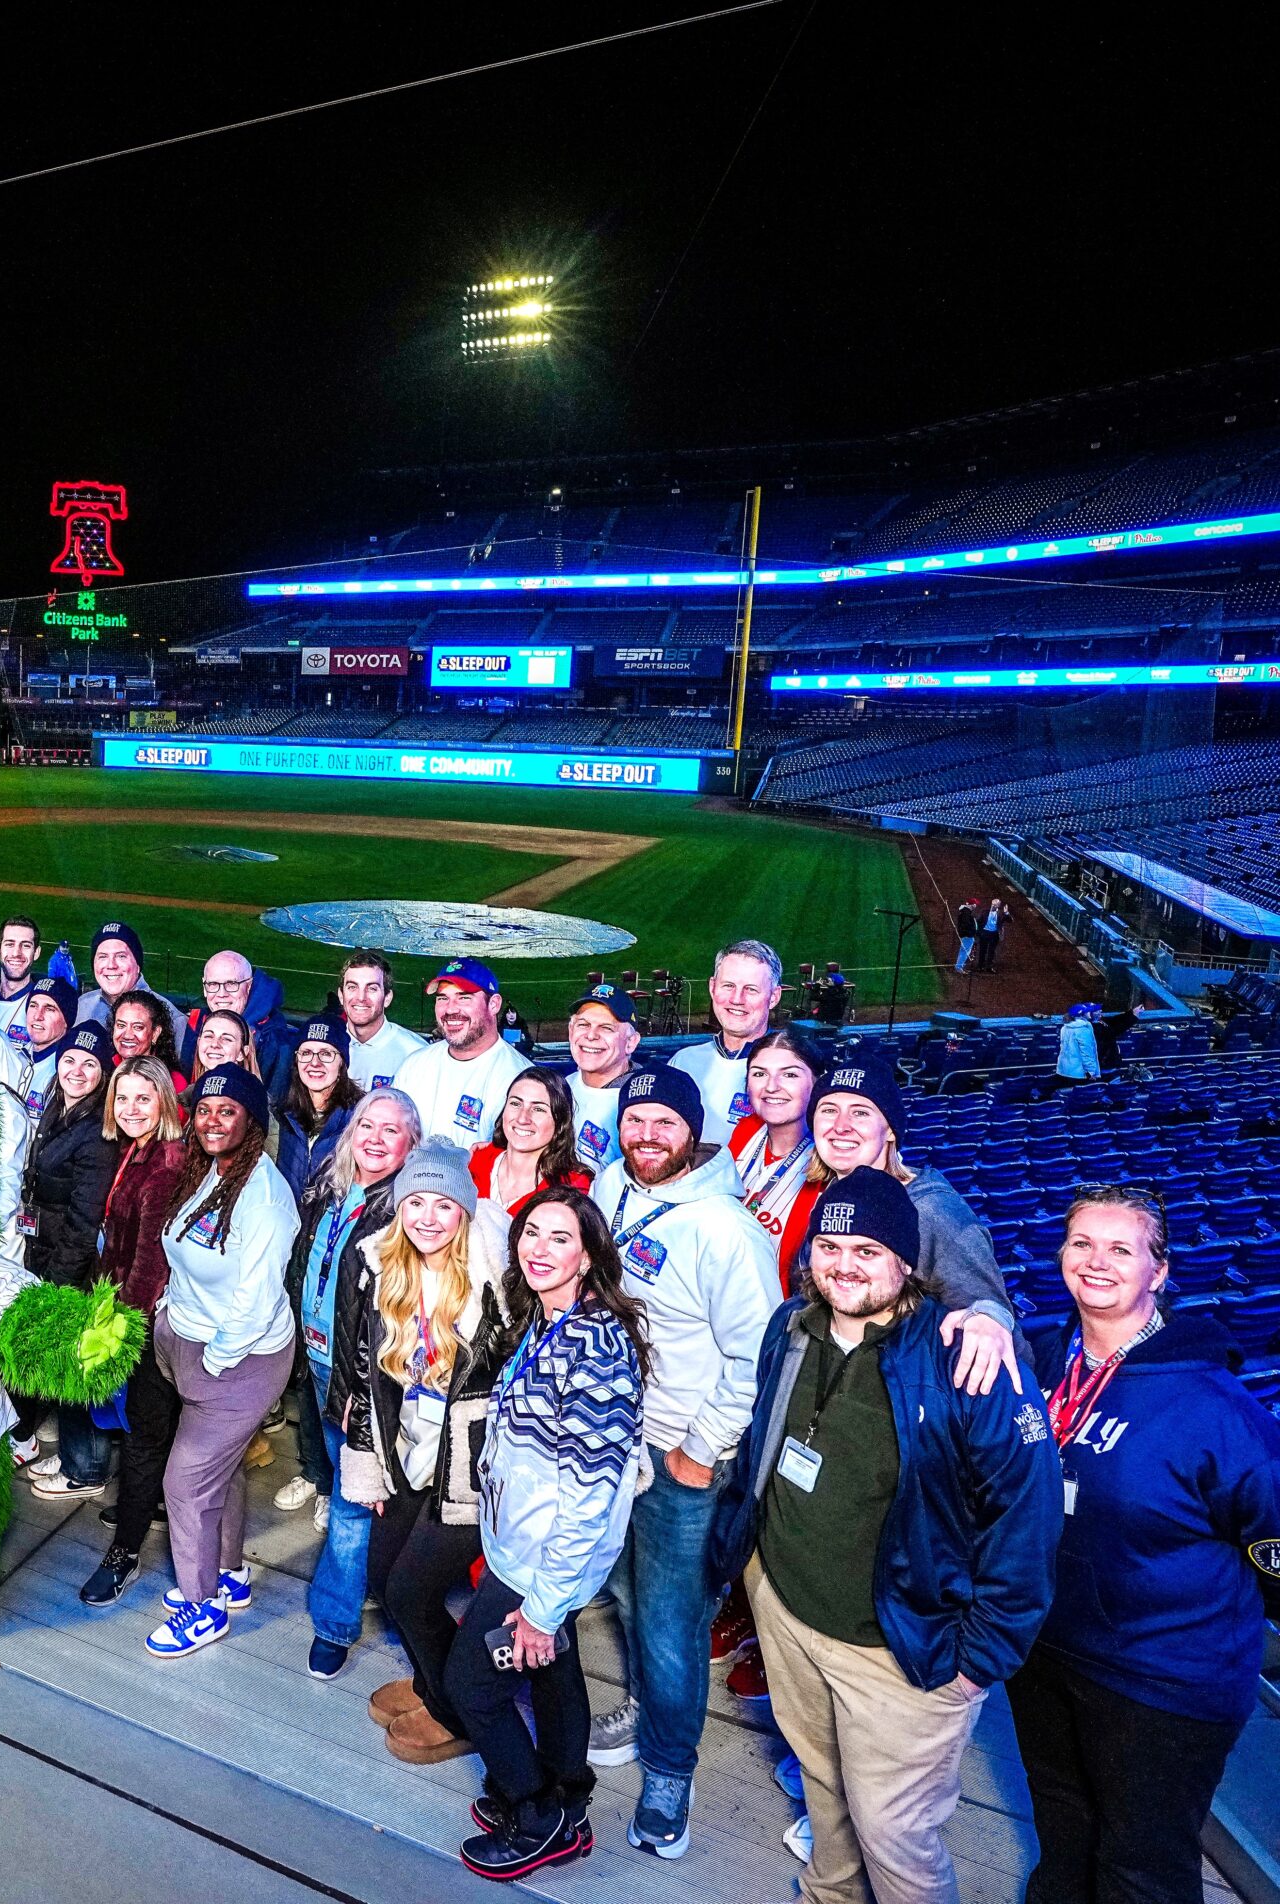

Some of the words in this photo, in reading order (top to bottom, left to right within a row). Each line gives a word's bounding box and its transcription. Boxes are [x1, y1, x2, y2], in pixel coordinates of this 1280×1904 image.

[44, 611, 94, 627] Citizens
[96, 612, 127, 627] Bank
[71, 627, 99, 640] Park
[334, 654, 402, 668] TOYOTA
[615, 648, 663, 660] ESPN
[664, 649, 702, 661] BET
[449, 657, 483, 670] SLEEP
[484, 657, 506, 670] OUT
[1214, 668, 1240, 676] SLEEP
[1239, 667, 1255, 676] OUT
[146, 749, 183, 765] SLEEP
[184, 749, 208, 765] OUT
[239, 751, 262, 767] ONE
[265, 752, 324, 769] PURPOSE.
[327, 754, 352, 770] ONE
[355, 755, 397, 772] NIGHT.
[401, 756, 426, 774] ONE
[429, 757, 516, 777] COMMUNITY.
[573, 762, 623, 782] SLEEP
[624, 764, 655, 784] OUT
[716, 766, 732, 776] 330
[308, 1024, 329, 1033] SLEEP
[77, 1031, 98, 1043] SLEEP
[313, 1030, 329, 1041] OUT
[81, 1039, 95, 1051] OUT
[833, 1069, 865, 1080] SLEEP
[205, 1076, 227, 1087] SLEEP
[630, 1075, 656, 1089] SLEEP
[841, 1076, 863, 1089] OUT
[208, 1085, 225, 1095] OUT
[633, 1085, 653, 1096] OUT
[784, 1136, 811, 1168] PHILADELPHIA
[822, 1206, 855, 1220] SLEEP
[624, 1220, 644, 1239] PHILLY
[831, 1219, 854, 1234] OUT
[1014, 1409, 1043, 1426] WORLD
[1023, 1429, 1048, 1444] SERIES
